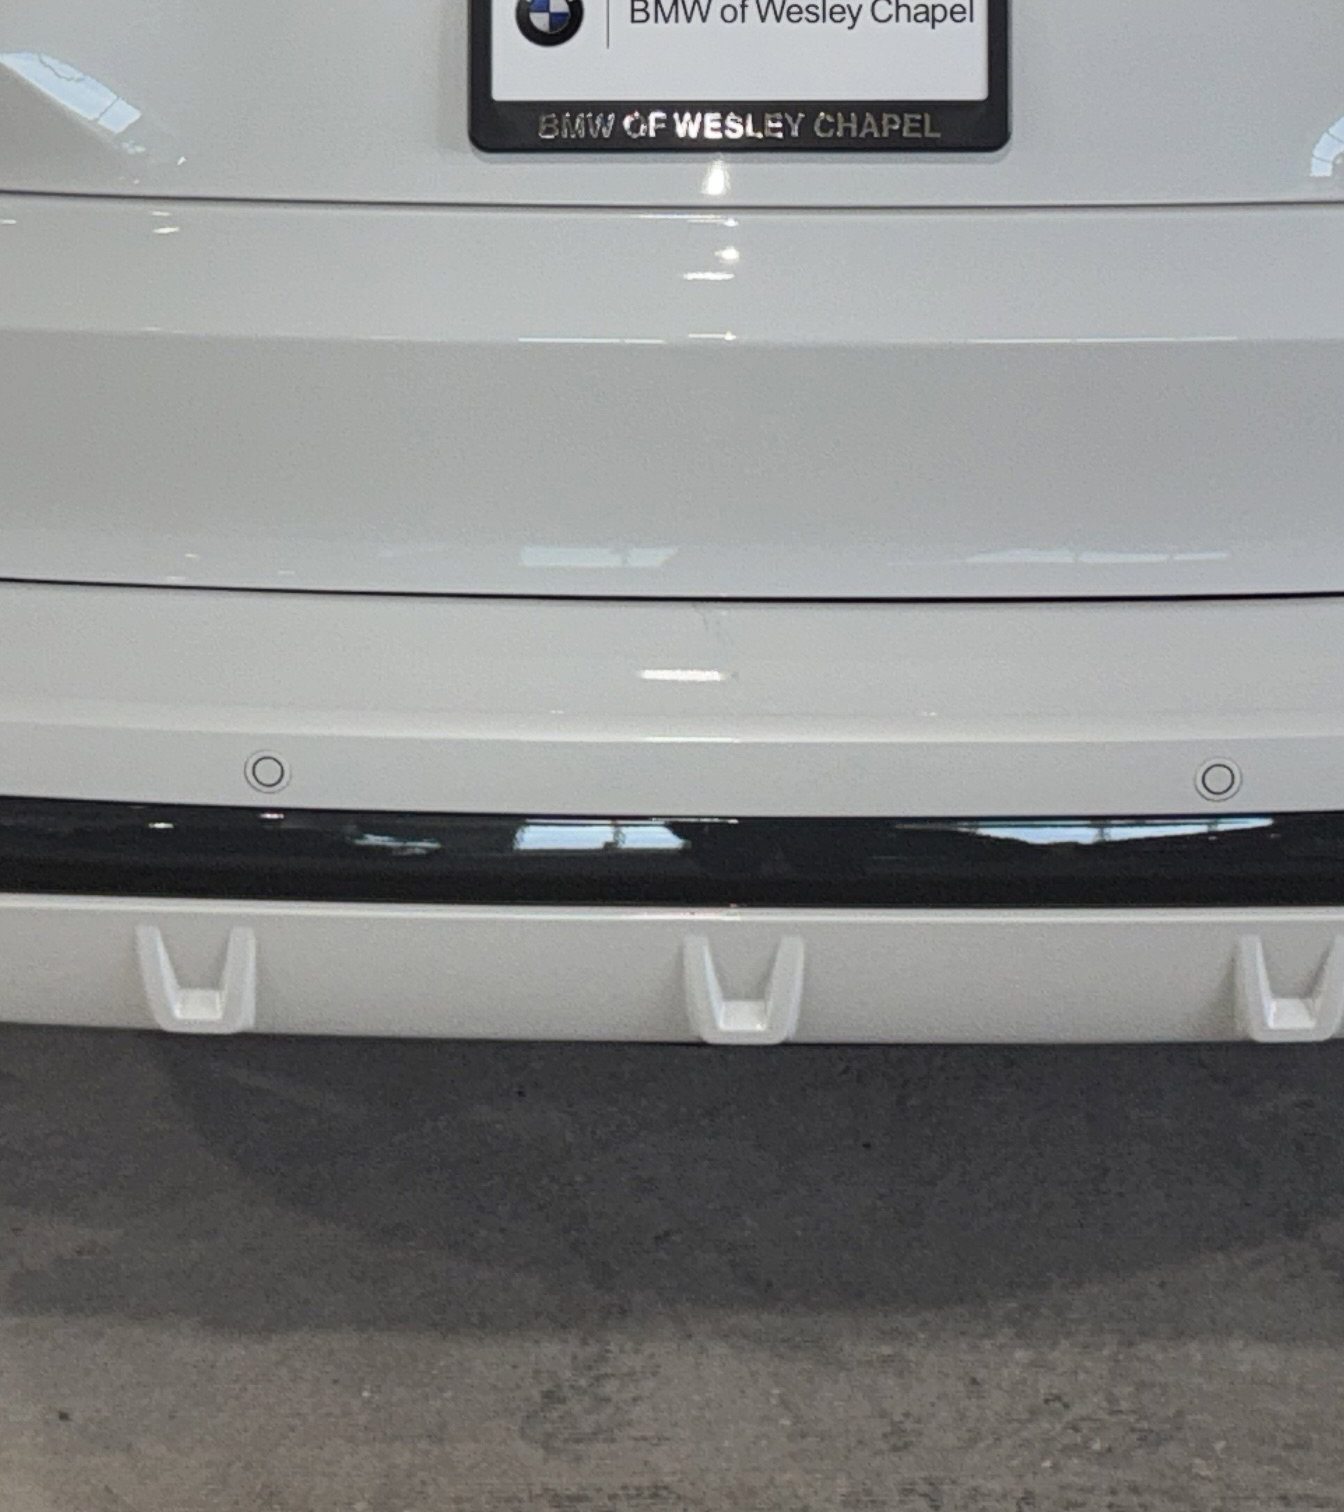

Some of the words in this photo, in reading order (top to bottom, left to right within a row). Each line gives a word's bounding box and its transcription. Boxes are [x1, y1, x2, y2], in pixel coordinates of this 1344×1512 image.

[538, 111, 616, 140] BMW
[622, 110, 667, 140] OF
[672, 111, 806, 140] WESLEY
[814, 111, 942, 140] CHAPEL
